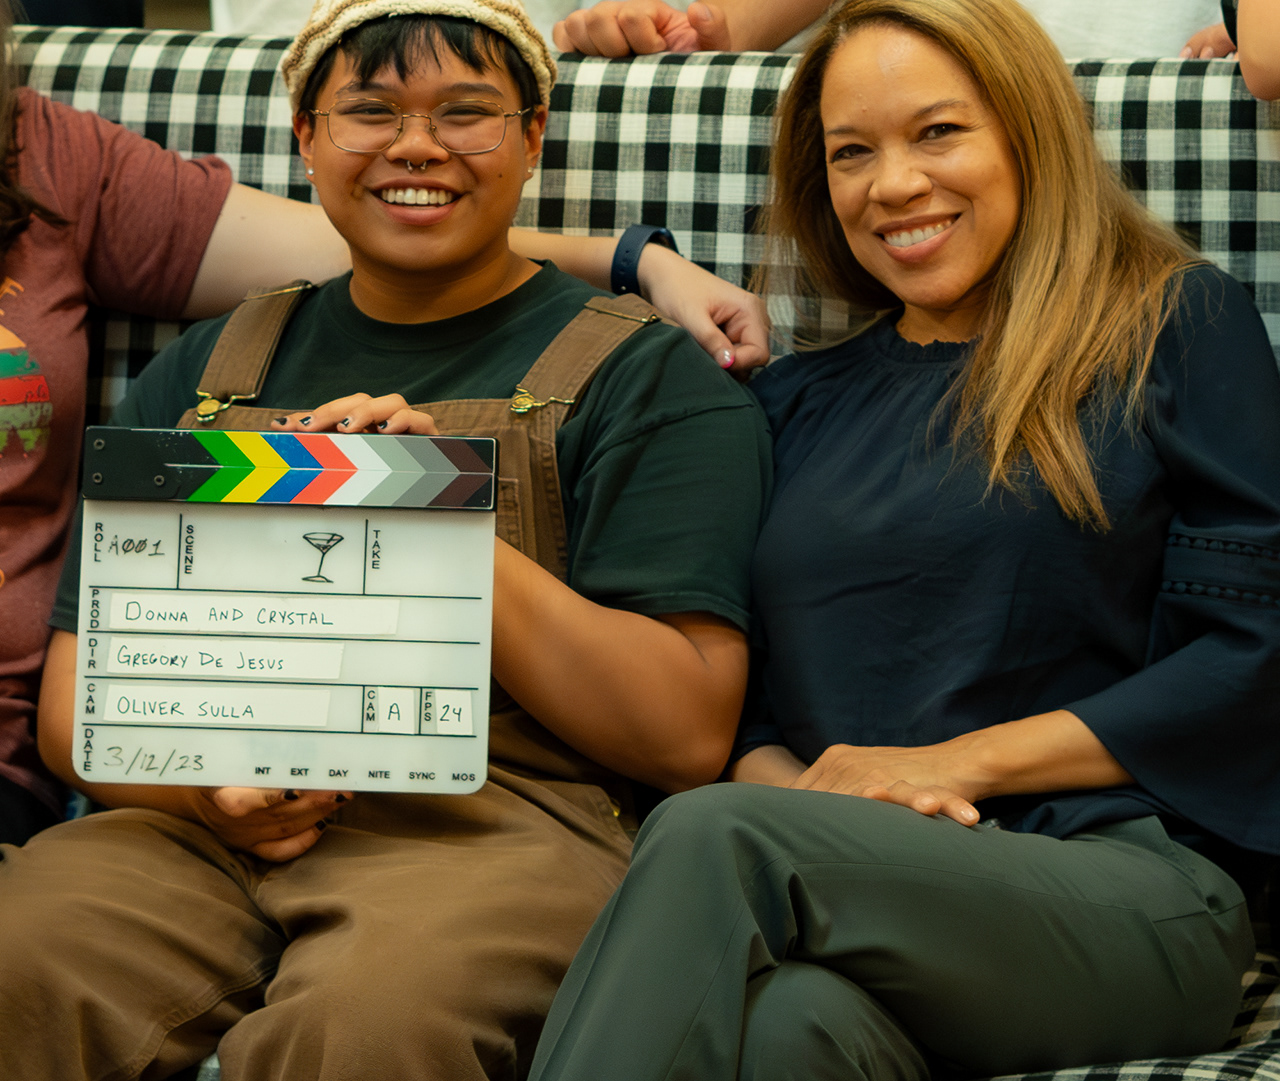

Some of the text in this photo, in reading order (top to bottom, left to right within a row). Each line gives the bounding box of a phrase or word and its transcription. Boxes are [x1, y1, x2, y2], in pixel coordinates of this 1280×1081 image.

[93, 522, 104, 563] ROLL
[184, 524, 195, 575] SCENE
[370, 529, 381, 570] TAKE
[90, 589, 100, 629] PROD
[125, 601, 335, 626] DONNA AND CRYSTAL
[88, 638, 98, 669] DIR
[117, 645, 189, 669] GREGORY
[236, 652, 284, 670] JESUS
[85, 683, 96, 715] CAM
[117, 696, 255, 719] OLIVER SULLA
[366, 690, 376, 722] CAM
[387, 702, 401, 721] A
[423, 691, 433, 722] FPS
[439, 704, 463, 723] 24
[83, 728, 94, 771] DATE
[255, 766, 476, 782] INT EXT DAY NITE SYNC MOS
